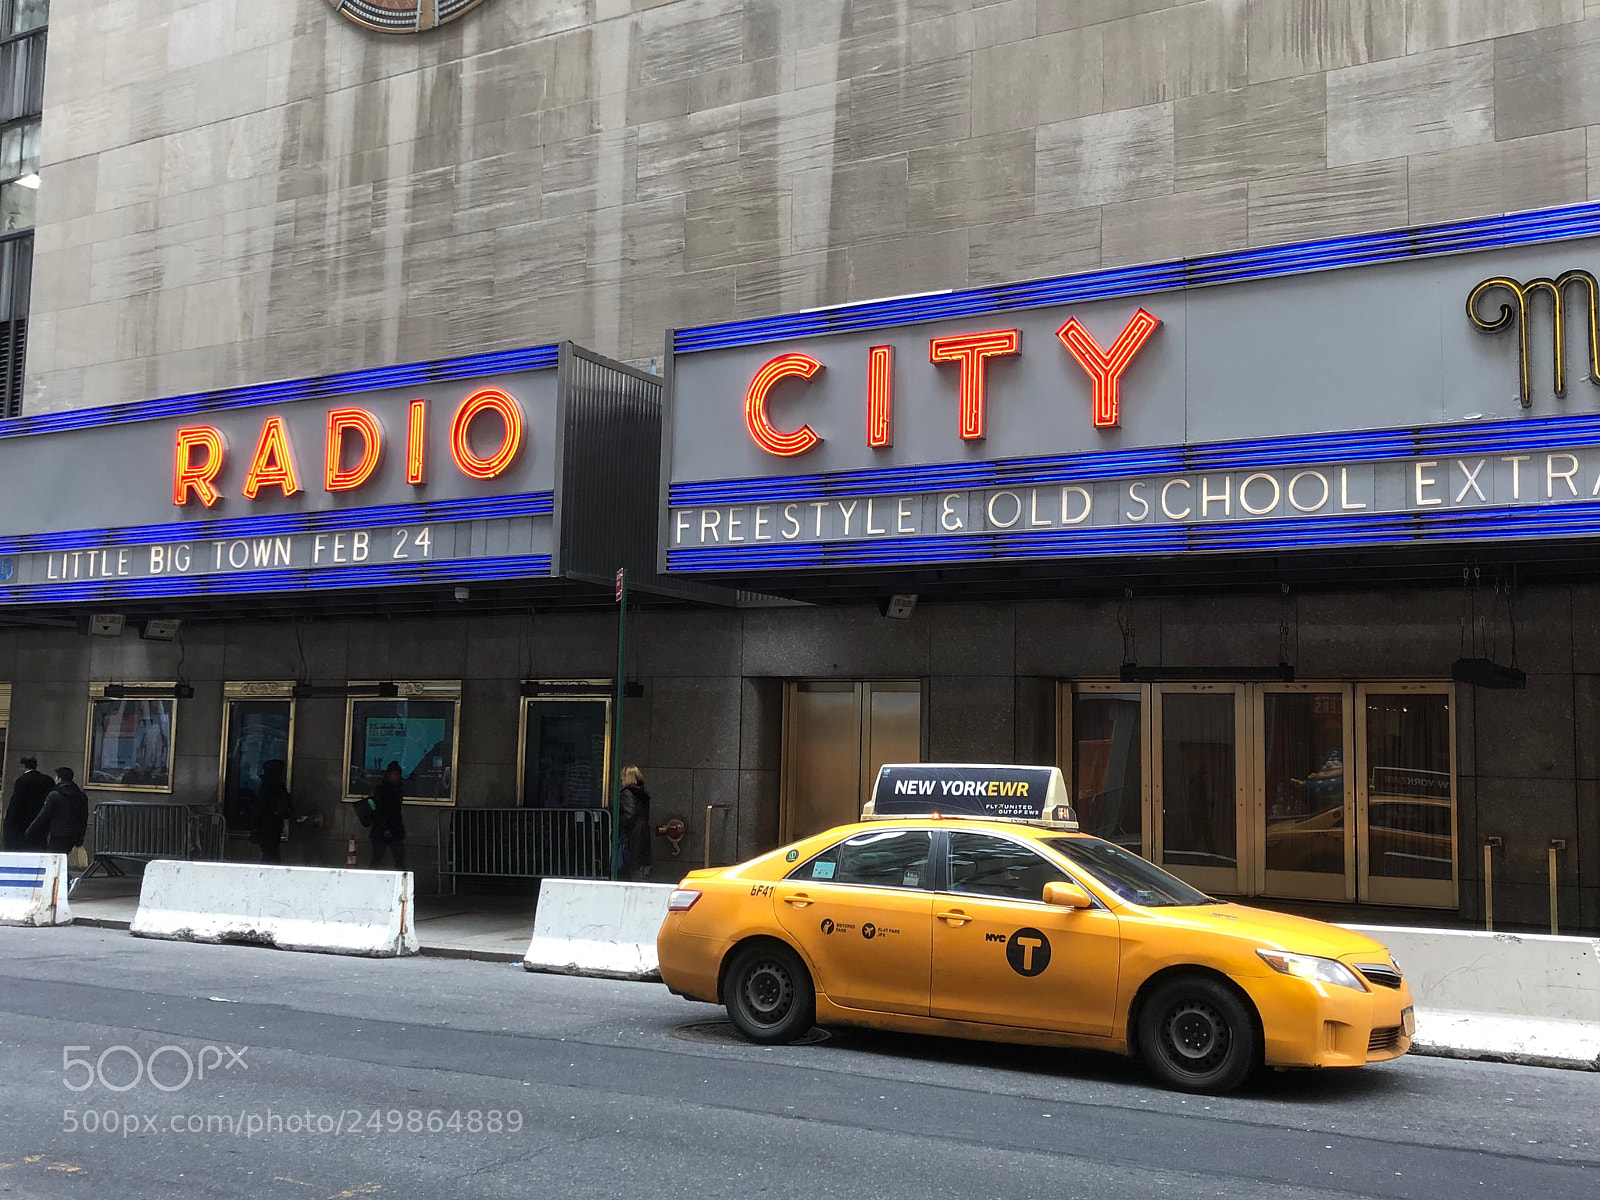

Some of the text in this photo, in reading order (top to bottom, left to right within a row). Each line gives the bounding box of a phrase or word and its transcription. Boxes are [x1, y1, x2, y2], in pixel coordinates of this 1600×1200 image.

[743, 306, 1161, 458] CITY
[173, 387, 526, 508] RADIO
[676, 497, 916, 544] FREESTYLE
[941, 493, 964, 531] &
[987, 485, 1093, 528] OLD
[1125, 467, 1367, 522] SCHOOL
[47, 526, 432, 580] LITTLE BIG TOWN FEB 24
[894, 780, 1030, 798] NEW YORKEWR
[985, 932, 1042, 971] NYC T
